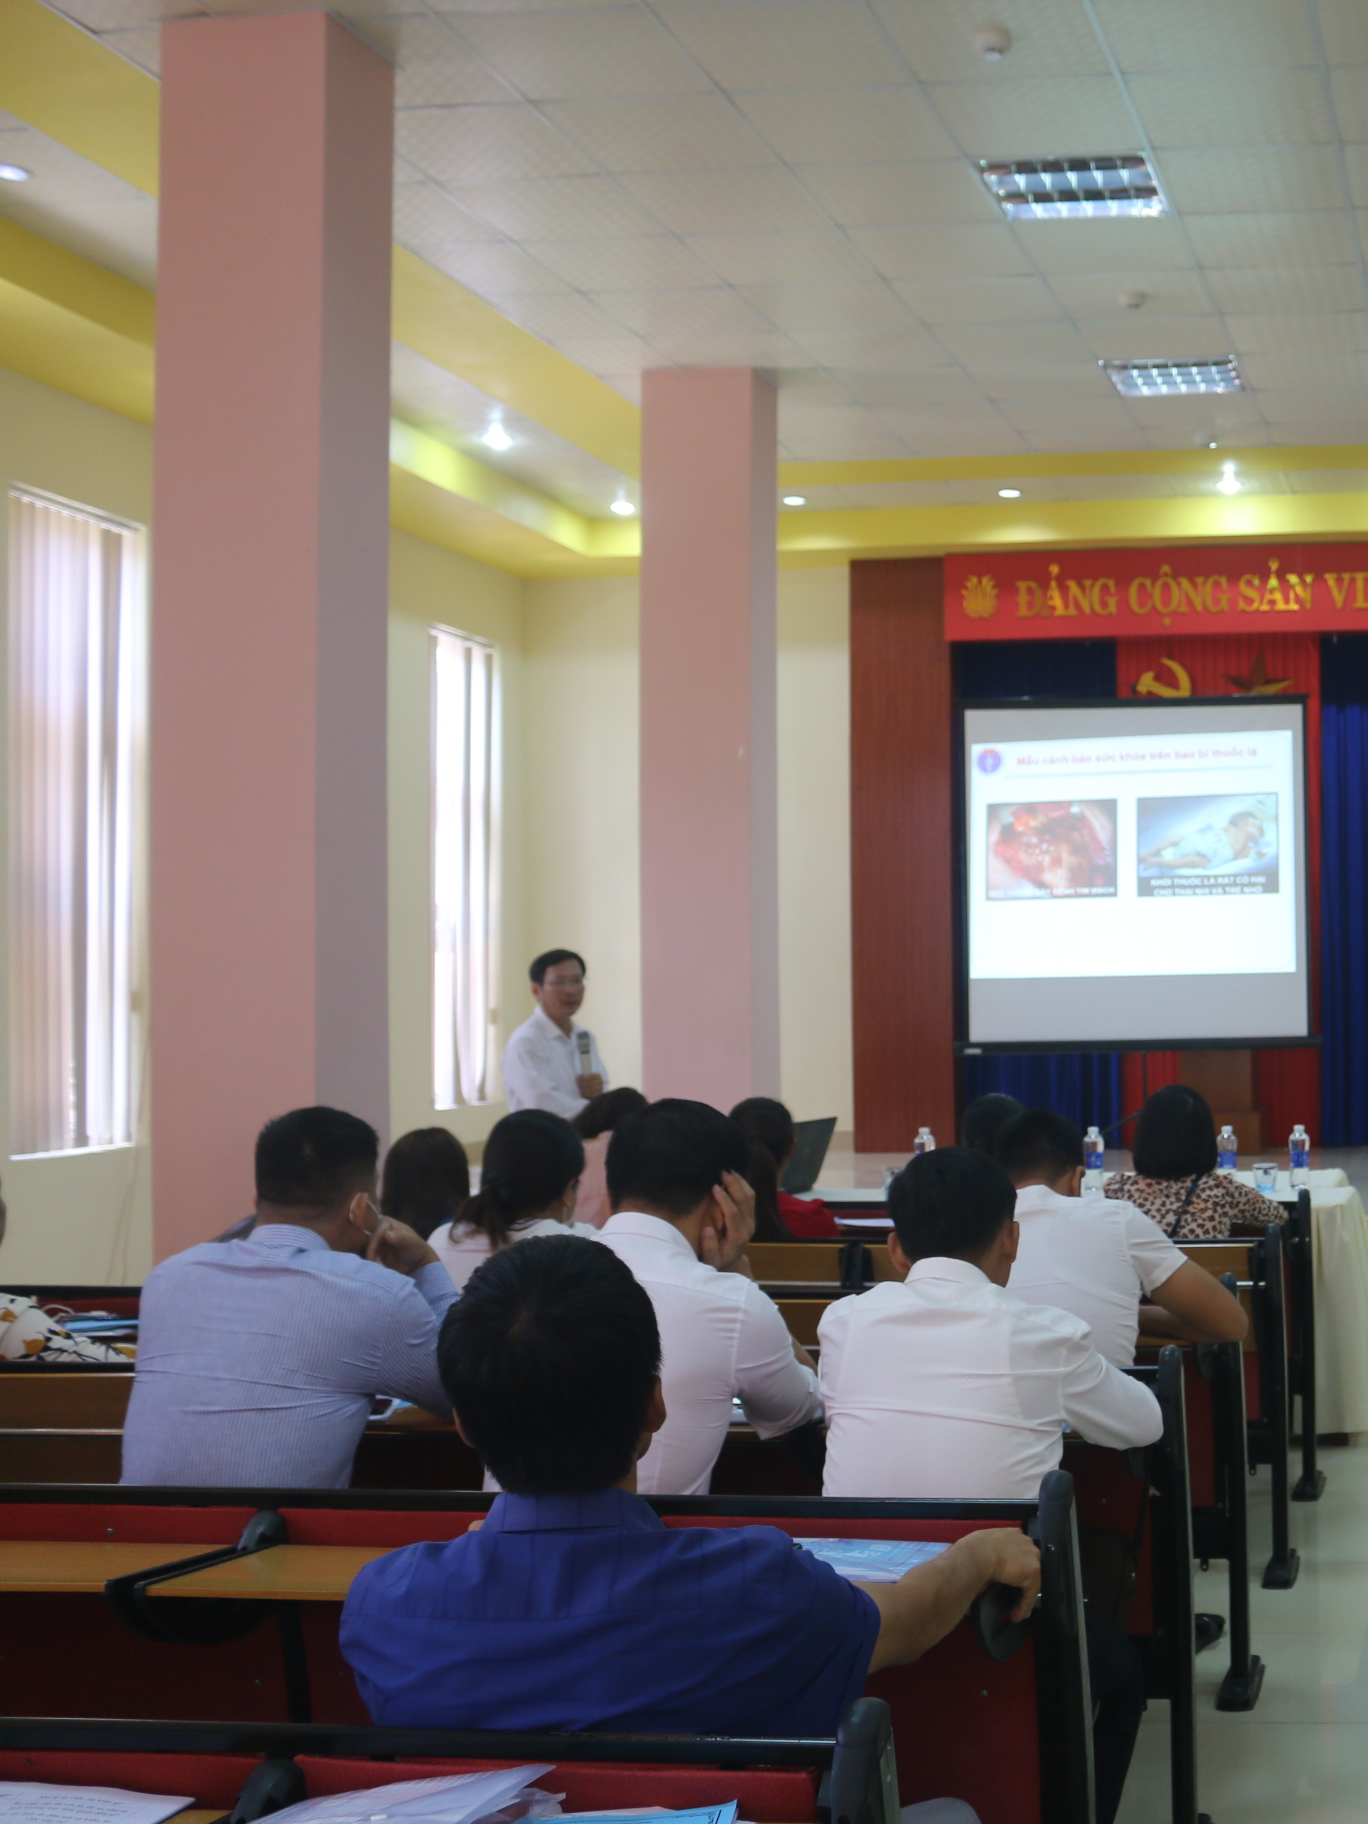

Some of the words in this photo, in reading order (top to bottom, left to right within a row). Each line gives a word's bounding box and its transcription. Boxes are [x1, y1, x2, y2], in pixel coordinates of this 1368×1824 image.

[1015, 563, 1118, 617] ĐẢNG
[1128, 564, 1229, 627] CỘNG
[1238, 558, 1315, 612] SẢN
